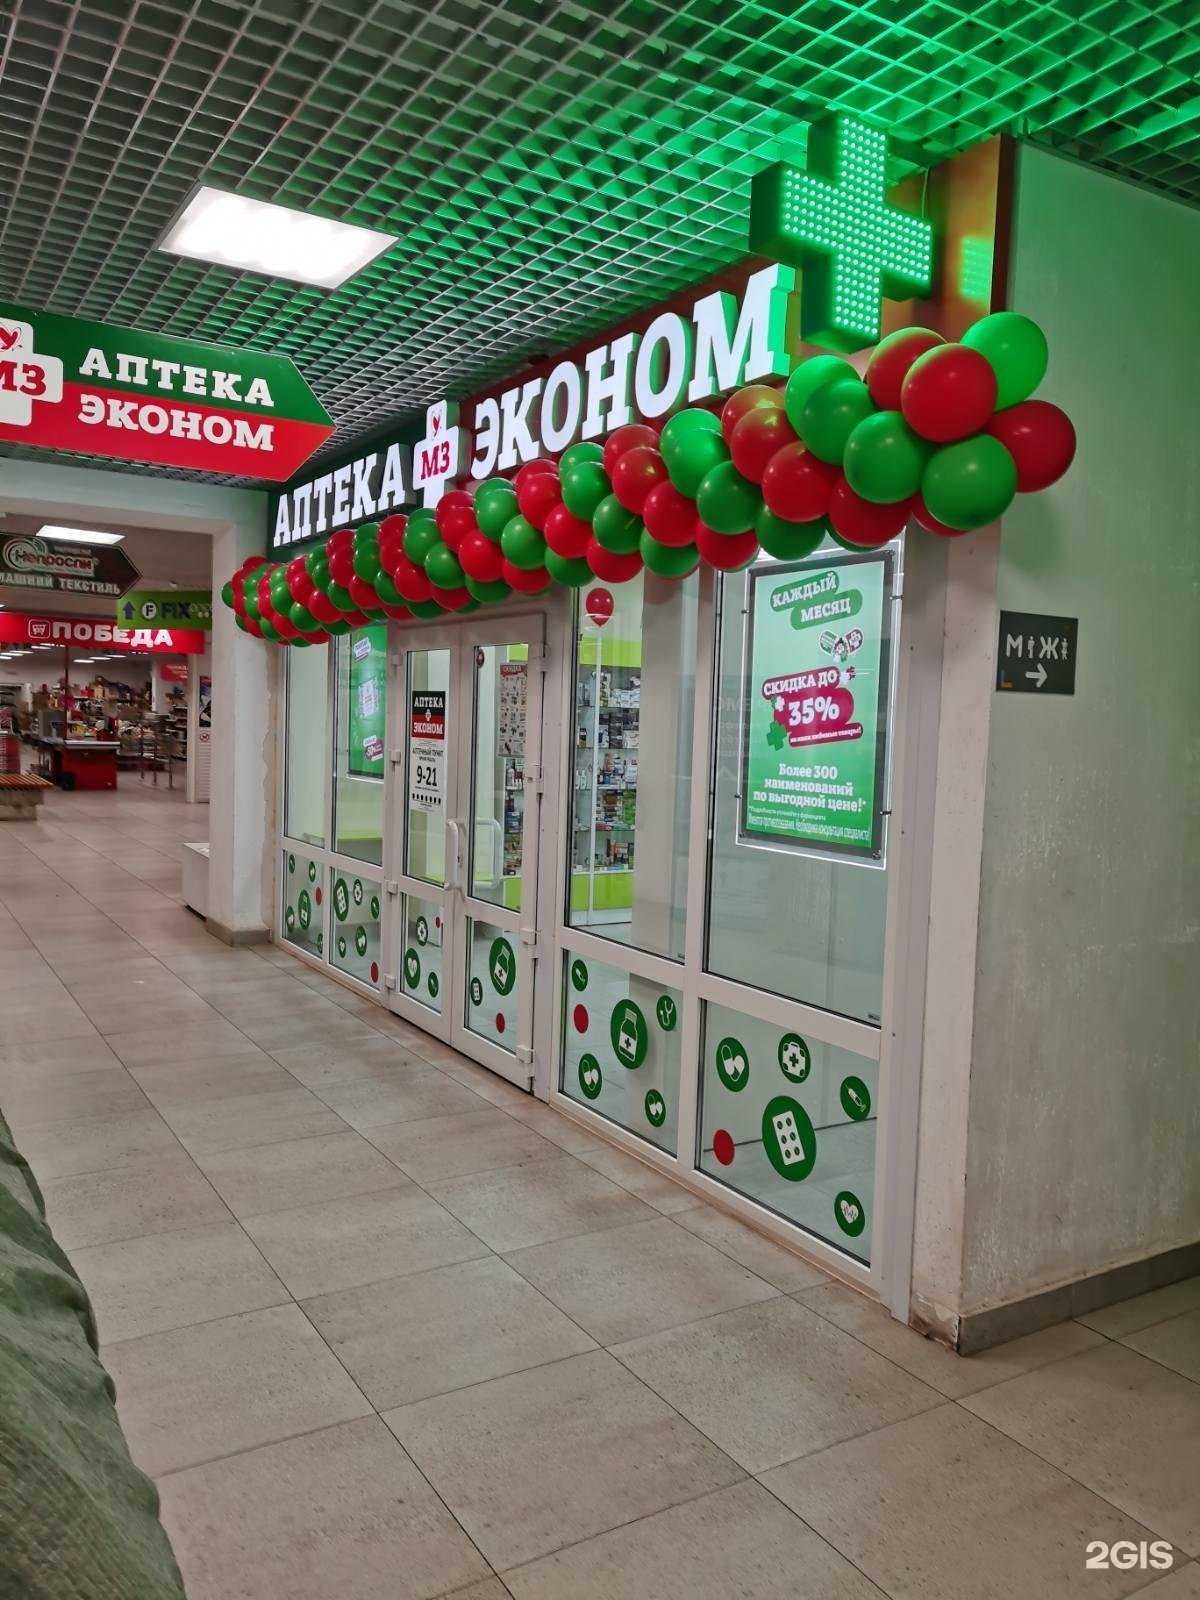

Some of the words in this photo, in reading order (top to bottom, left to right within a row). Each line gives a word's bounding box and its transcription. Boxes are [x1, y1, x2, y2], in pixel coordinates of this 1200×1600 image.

[79, 348, 274, 407] АПТЕКА
[273, 443, 405, 547] АПТЕКА
[420, 440, 450, 480] МЗ
[470, 264, 790, 480] ЭКОНОМ
[77, 394, 274, 451] ЭКОНОМ
[58, 578, 120, 594] ТЕКСТИЛЬ
[772, 572, 837, 607] КАЖДЫЙ
[800, 597, 852, 622] МЕСЯЦ
[52, 621, 173, 647] ПОБЕДА
[1039, 635, 1059, 659] Ж
[763, 674, 817, 695] СКИДКА
[818, 669, 838, 688] ДО
[414, 697, 443, 708] АПТЕКА
[788, 696, 839, 726] 35%
[413, 722, 443, 735] ЭКОНОМ
[416, 765, 437, 786] 9-21
[779, 763, 812, 778] Более
[814, 765, 838, 780] 300
[764, 778, 854, 796] наименований
[753, 791, 767, 801] по
[768, 793, 825, 808] выгодной
